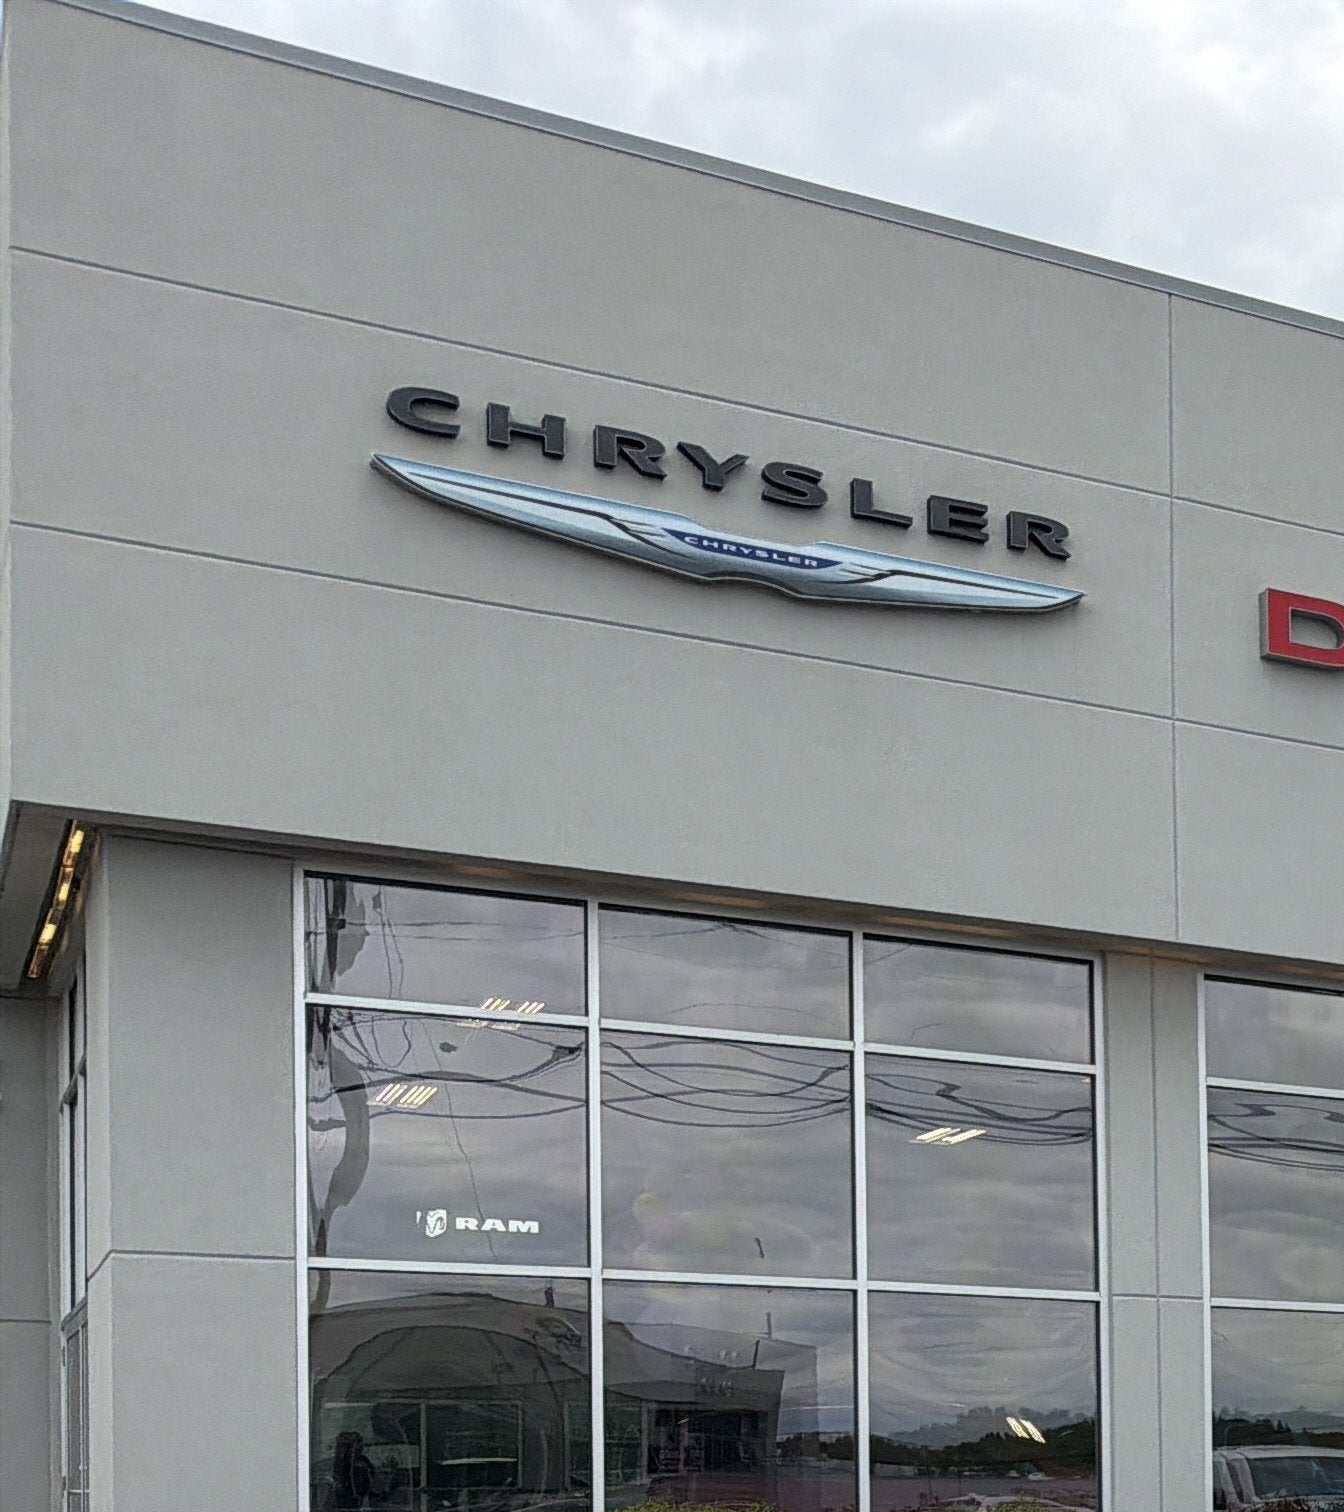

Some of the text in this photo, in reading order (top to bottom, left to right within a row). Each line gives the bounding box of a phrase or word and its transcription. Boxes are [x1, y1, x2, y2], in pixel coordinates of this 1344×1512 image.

[385, 385, 1071, 559] CHRYSLER
[684, 536, 818, 568] CHRYSLER
[455, 1216, 539, 1234] RAM
